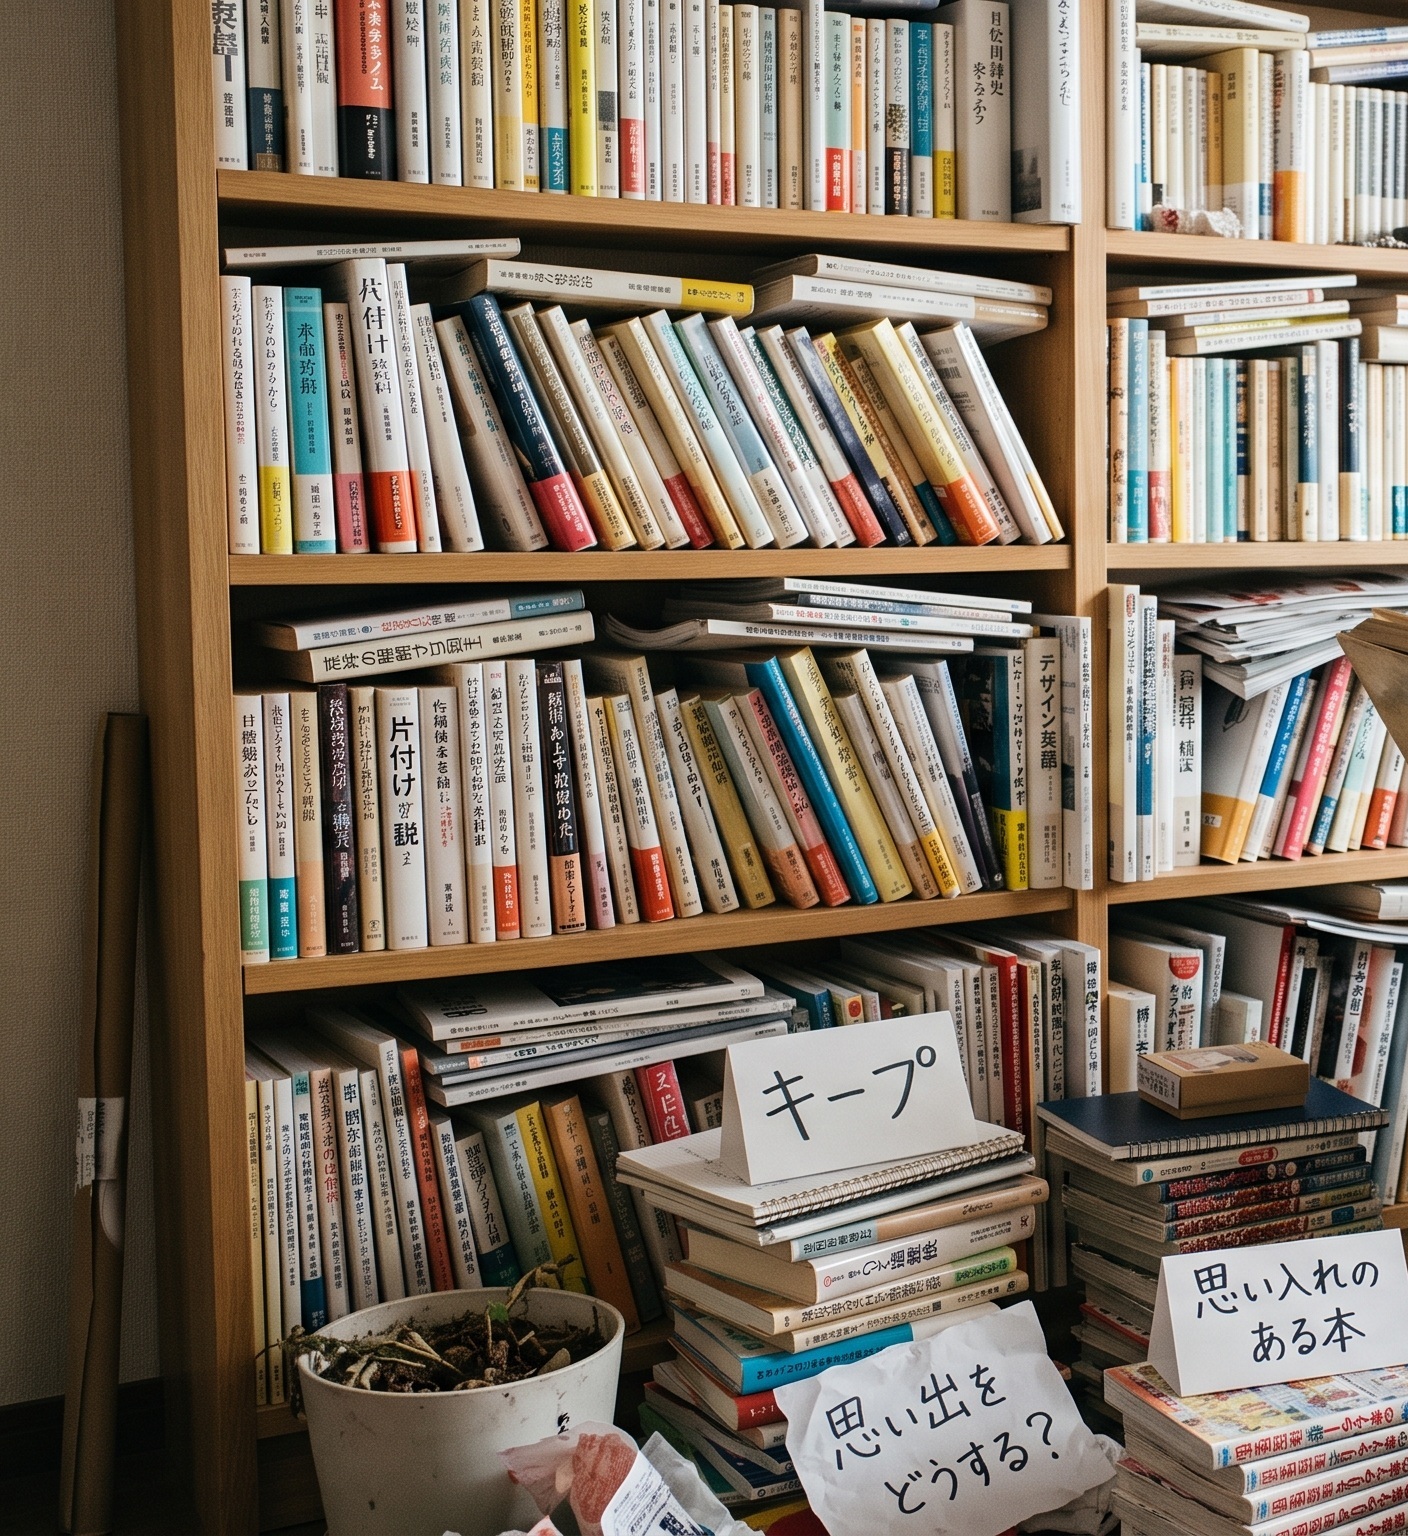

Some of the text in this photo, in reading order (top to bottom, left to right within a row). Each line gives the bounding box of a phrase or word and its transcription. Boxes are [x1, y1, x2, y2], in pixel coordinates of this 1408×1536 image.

[761, 1045, 937, 1141] キープ
[1193, 1258, 1379, 1319] 思い入れの
[1251, 1307, 1366, 1364] ある本
[825, 1364, 1007, 1471] 思い出を
[884, 1411, 1061, 1515] どうする?
